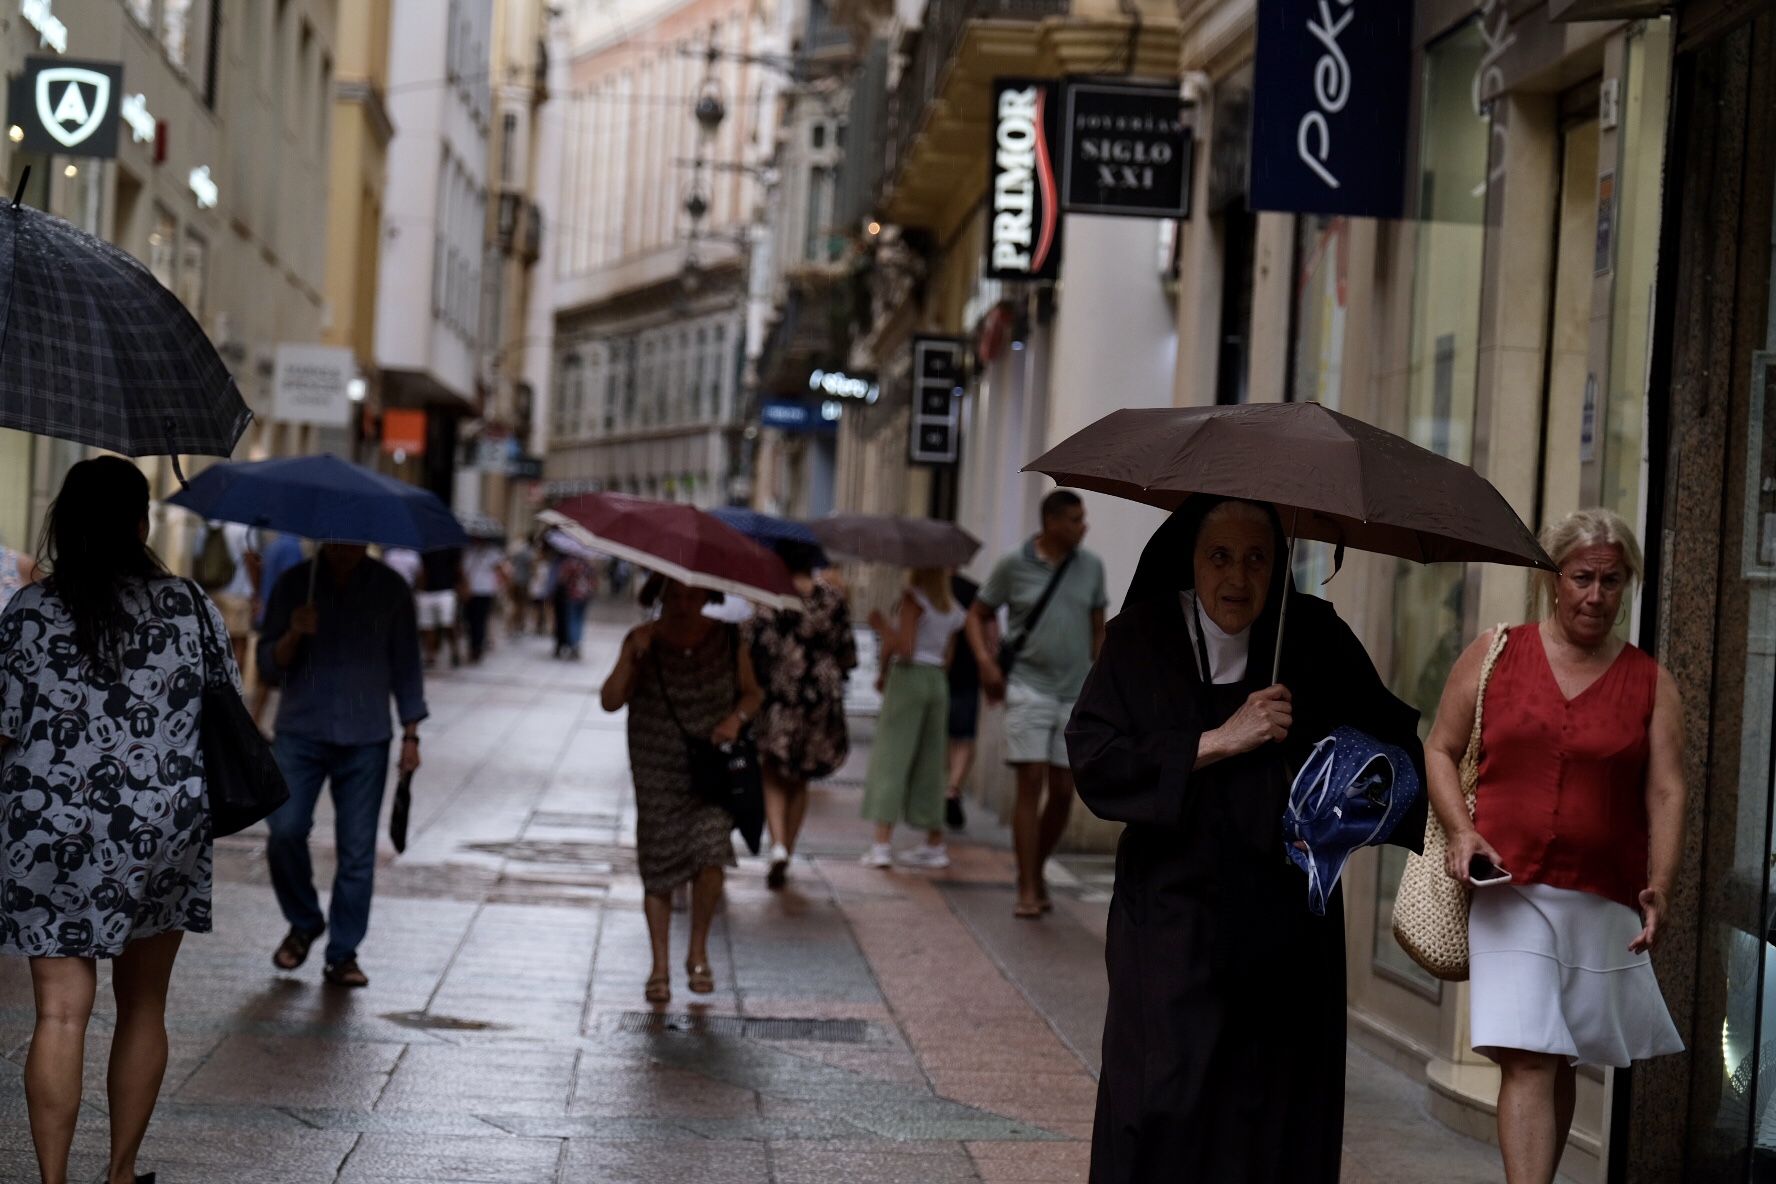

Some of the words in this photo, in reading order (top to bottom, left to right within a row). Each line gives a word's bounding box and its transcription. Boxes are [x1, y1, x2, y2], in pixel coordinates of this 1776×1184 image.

[1298, 0, 1354, 188] pek
[993, 85, 1037, 271] PRIMOR
[1080, 138, 1172, 166] SIGLO
[1098, 163, 1153, 190] XXI
